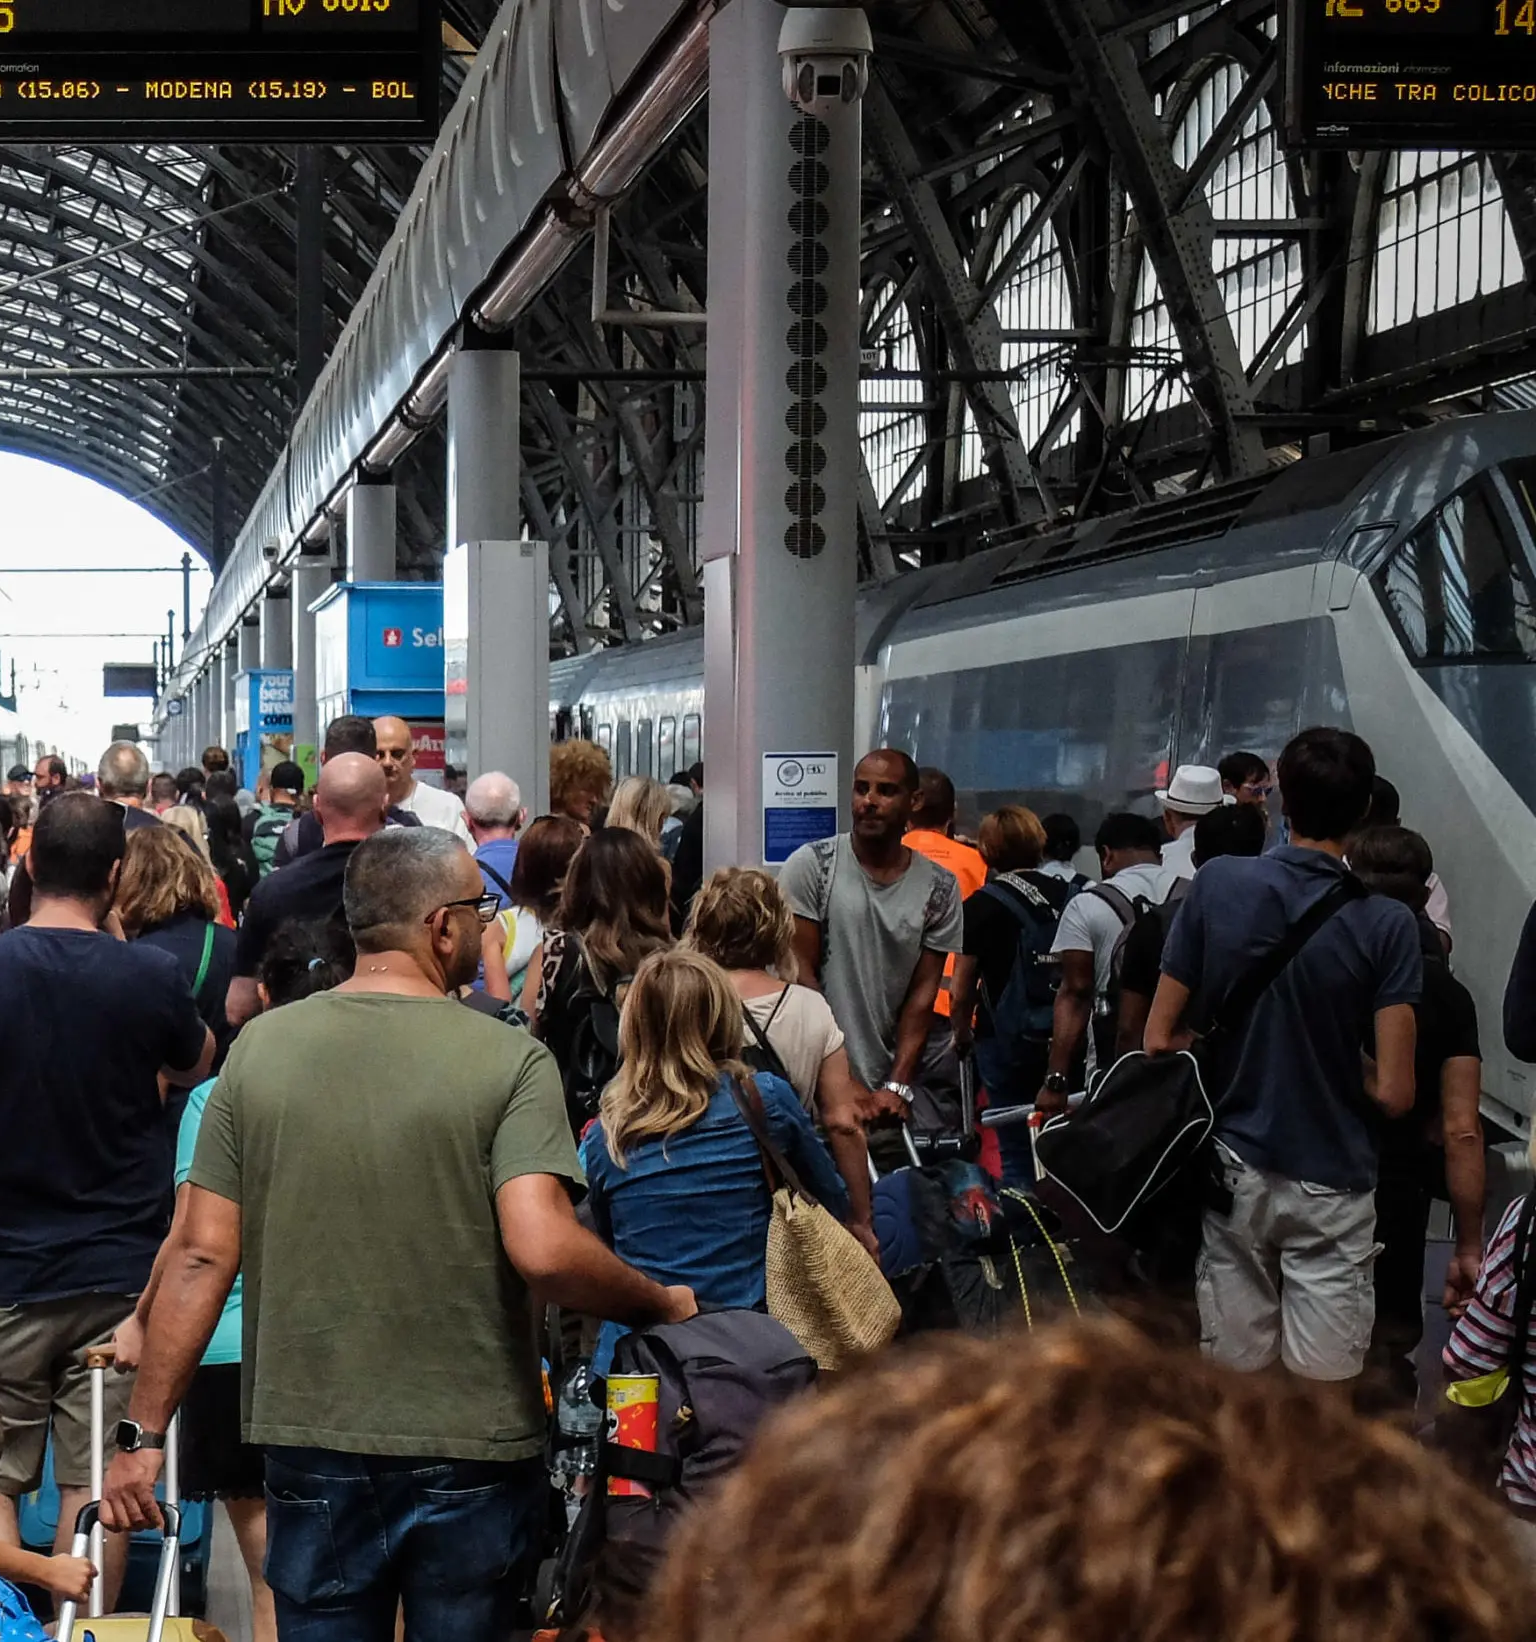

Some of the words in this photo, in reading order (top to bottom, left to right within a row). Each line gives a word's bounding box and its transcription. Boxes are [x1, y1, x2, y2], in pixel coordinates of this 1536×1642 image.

[1323, 62, 1400, 74] informazioni
[17, 82, 100, 99] (15.06)
[145, 82, 232, 99] MODENA
[248, 82, 327, 99] (15.19)
[372, 82, 414, 99] BOL
[1394, 84, 1437, 101] TRA
[1453, 85, 1536, 101] COLICO
[259, 687, 290, 700] best
